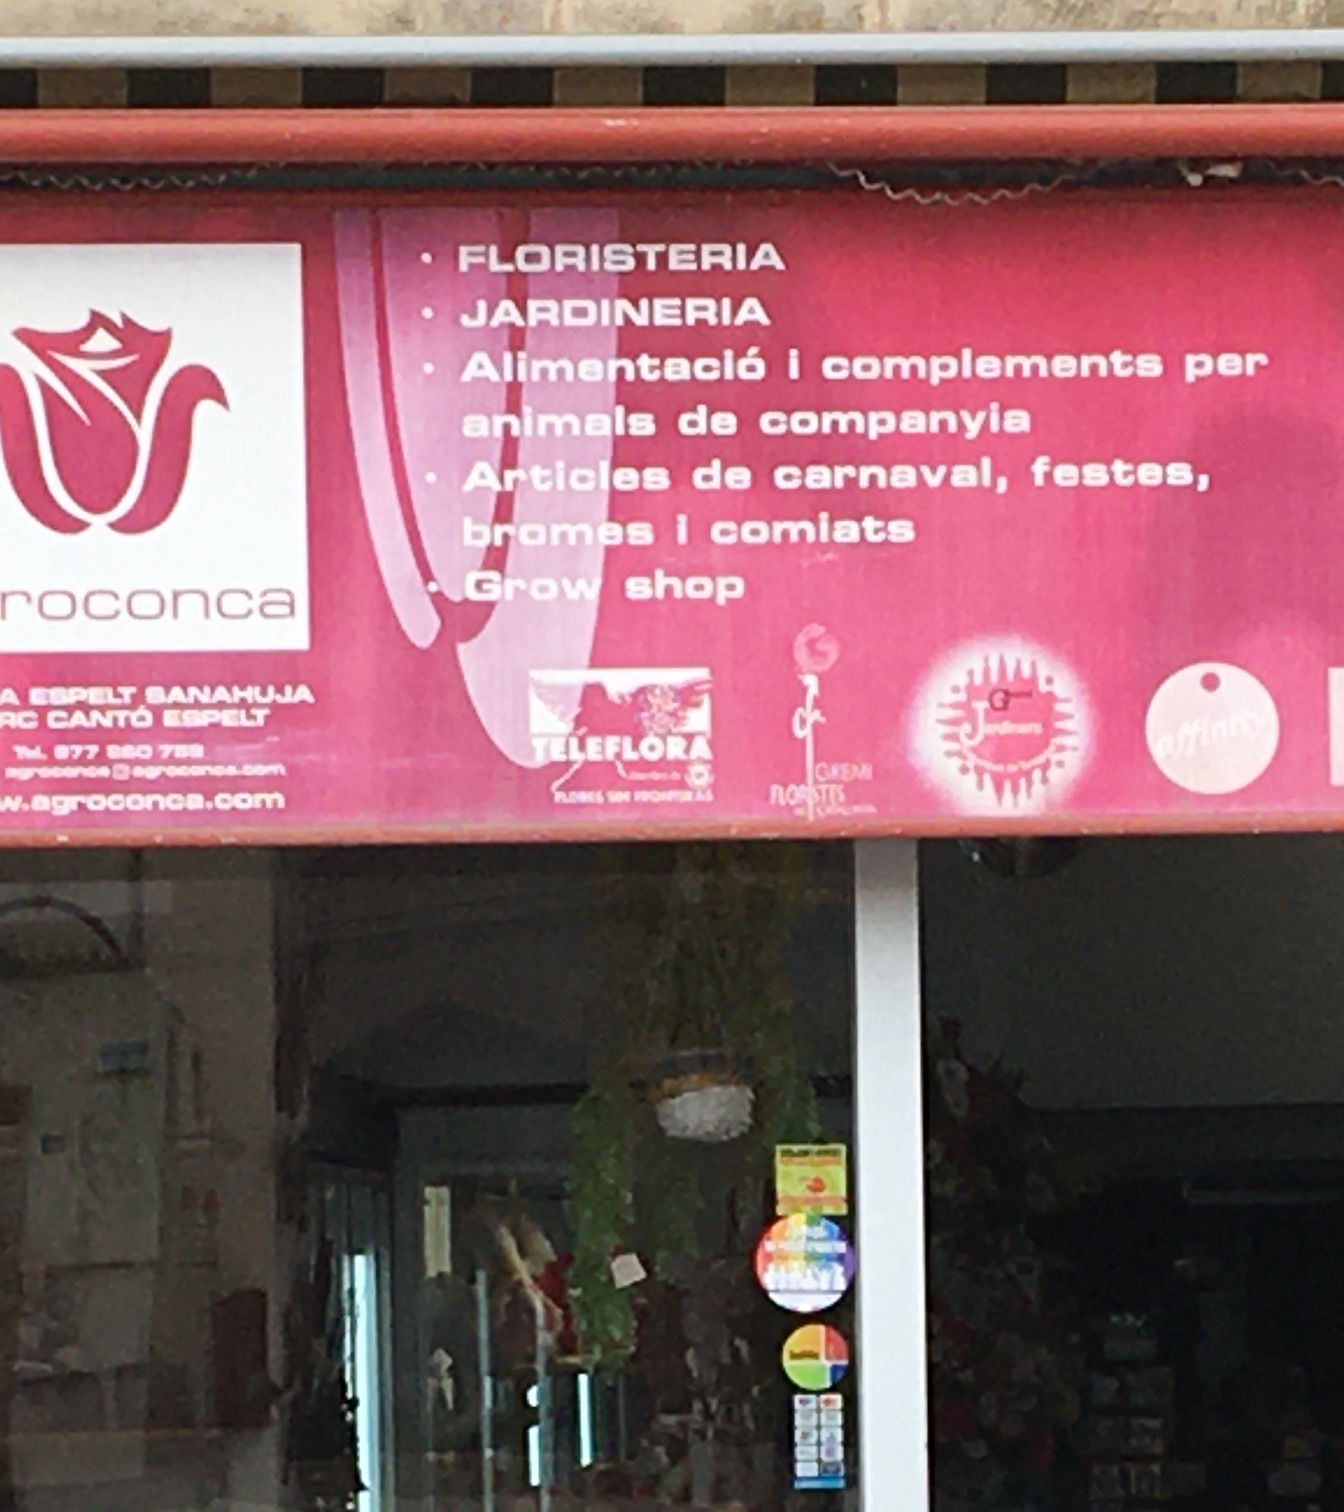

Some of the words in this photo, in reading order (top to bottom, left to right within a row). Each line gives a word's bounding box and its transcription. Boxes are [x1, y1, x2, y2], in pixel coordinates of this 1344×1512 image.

[458, 242, 786, 273] FLORISTERIA
[460, 297, 771, 328] JARDINERIA
[461, 347, 766, 382] Alimentació
[788, 348, 800, 381] i
[822, 348, 1164, 386] complements
[1184, 352, 1269, 382] per
[463, 404, 656, 438] animals
[677, 403, 738, 436] de
[759, 402, 1032, 439] companyia
[463, 459, 671, 492] Articles
[692, 458, 753, 490] de
[774, 457, 1008, 493] carnaval,
[1031, 456, 1211, 492] festes,
[462, 516, 655, 548] bromes
[677, 513, 689, 546] i
[710, 512, 915, 545] comiats
[465, 570, 602, 601] Grow
[625, 568, 745, 606] shop
[29, 686, 137, 705] ESPELT
[145, 684, 316, 705] SANAHUJA
[47, 706, 153, 730] CANTÓ
[163, 709, 271, 728] ESPELT
[531, 735, 714, 762] TELEFLORA
